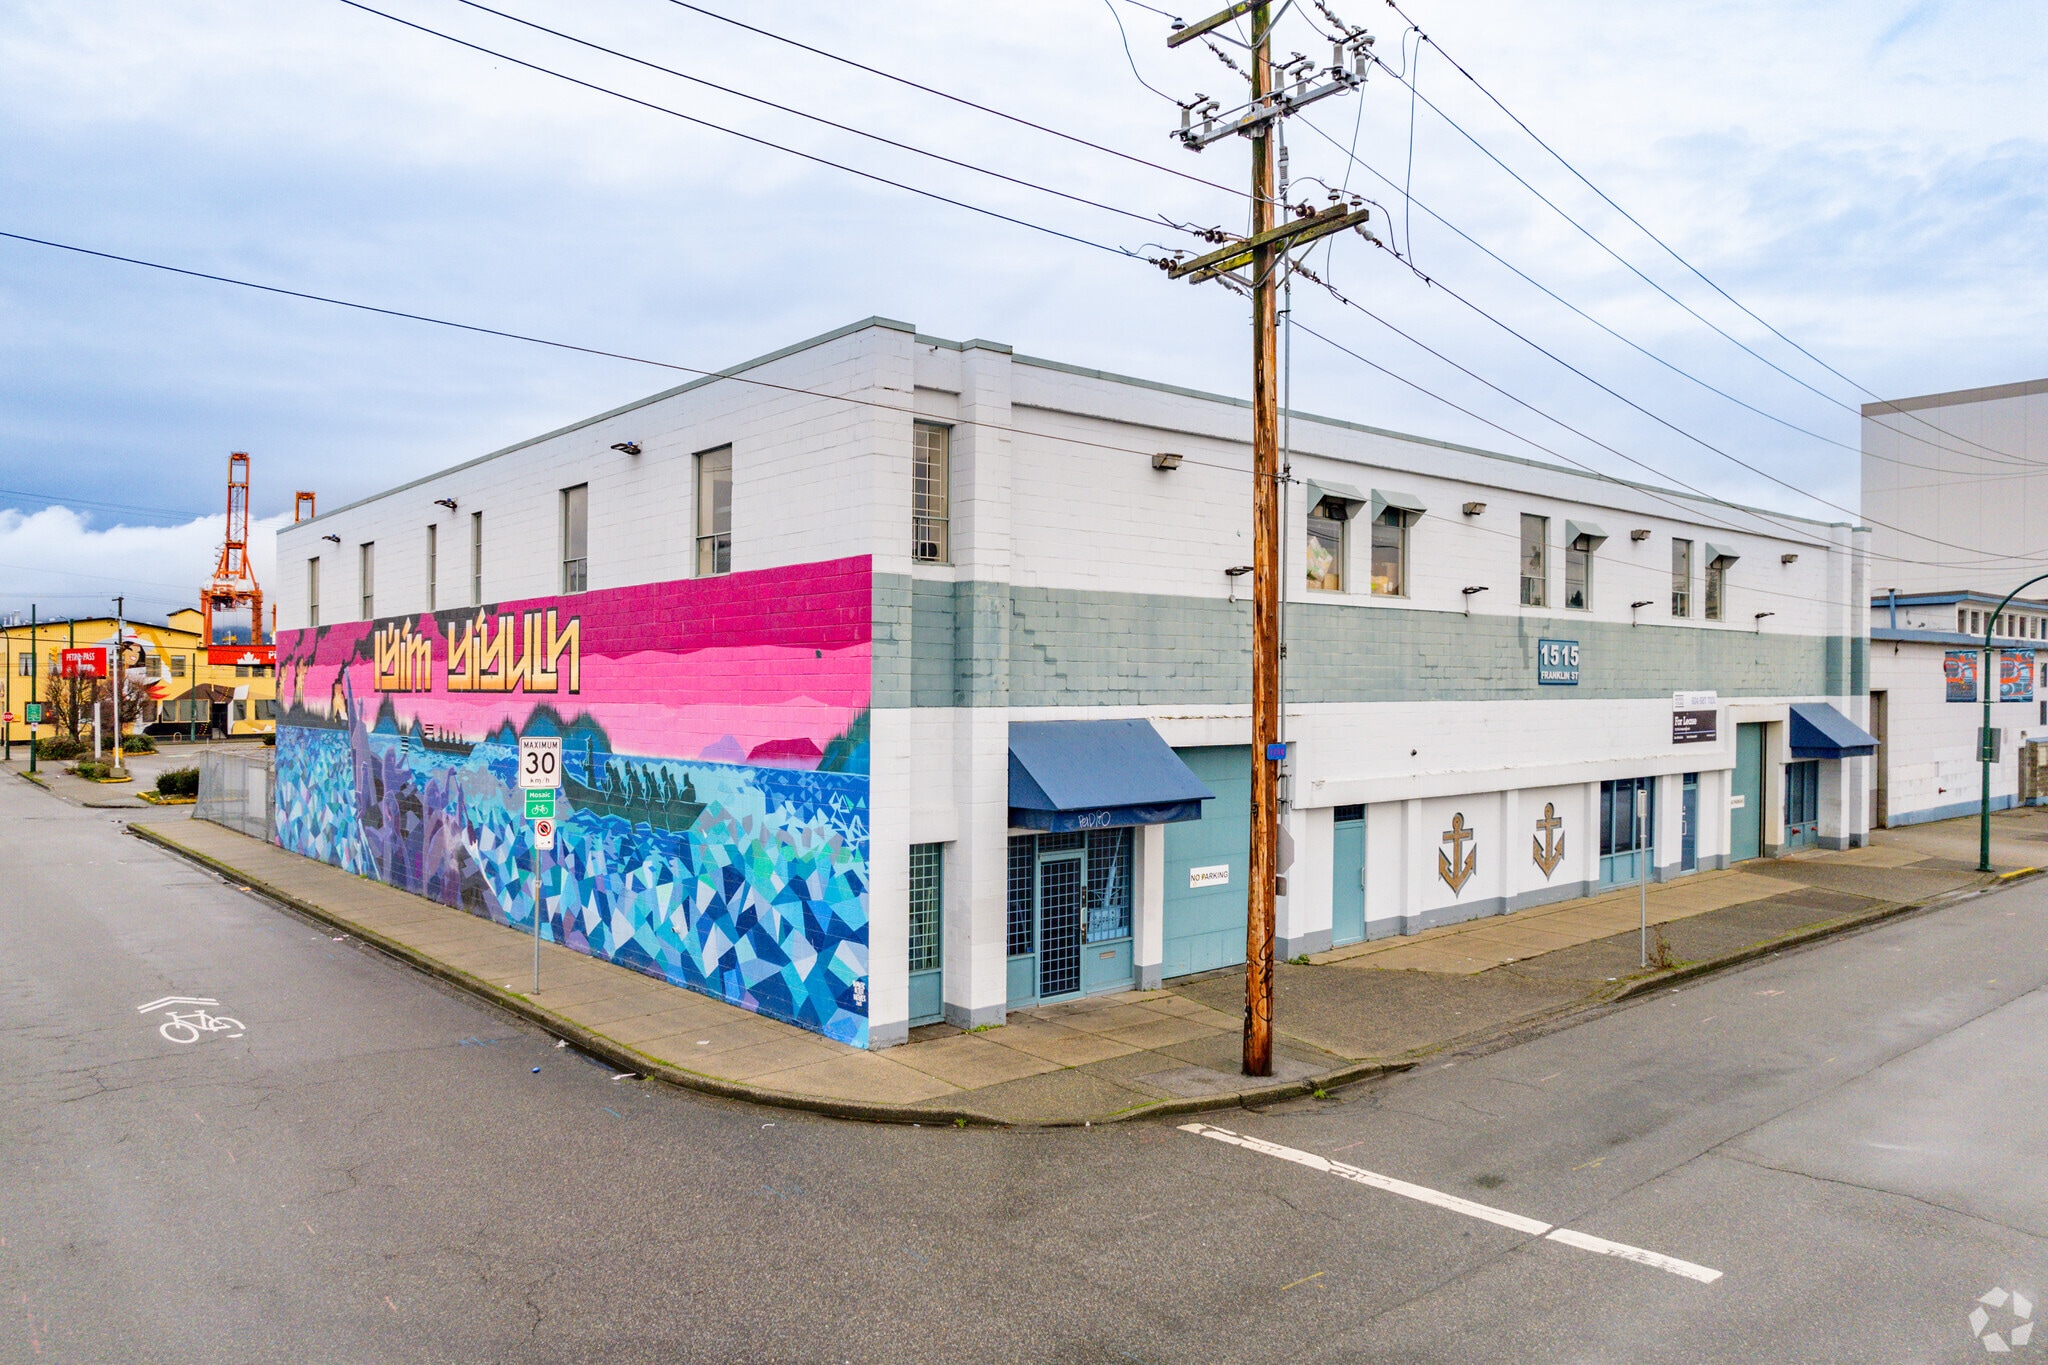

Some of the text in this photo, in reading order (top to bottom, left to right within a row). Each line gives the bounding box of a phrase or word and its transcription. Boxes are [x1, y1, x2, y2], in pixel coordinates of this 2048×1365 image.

[1541, 644, 1579, 666] 1515
[1541, 671, 1579, 680] FRANKLIN ST
[1674, 715, 1698, 726] For Lease
[523, 741, 558, 749] MAXIMUM
[525, 752, 555, 774] 30
[1190, 870, 1229, 882] NO PARKING
